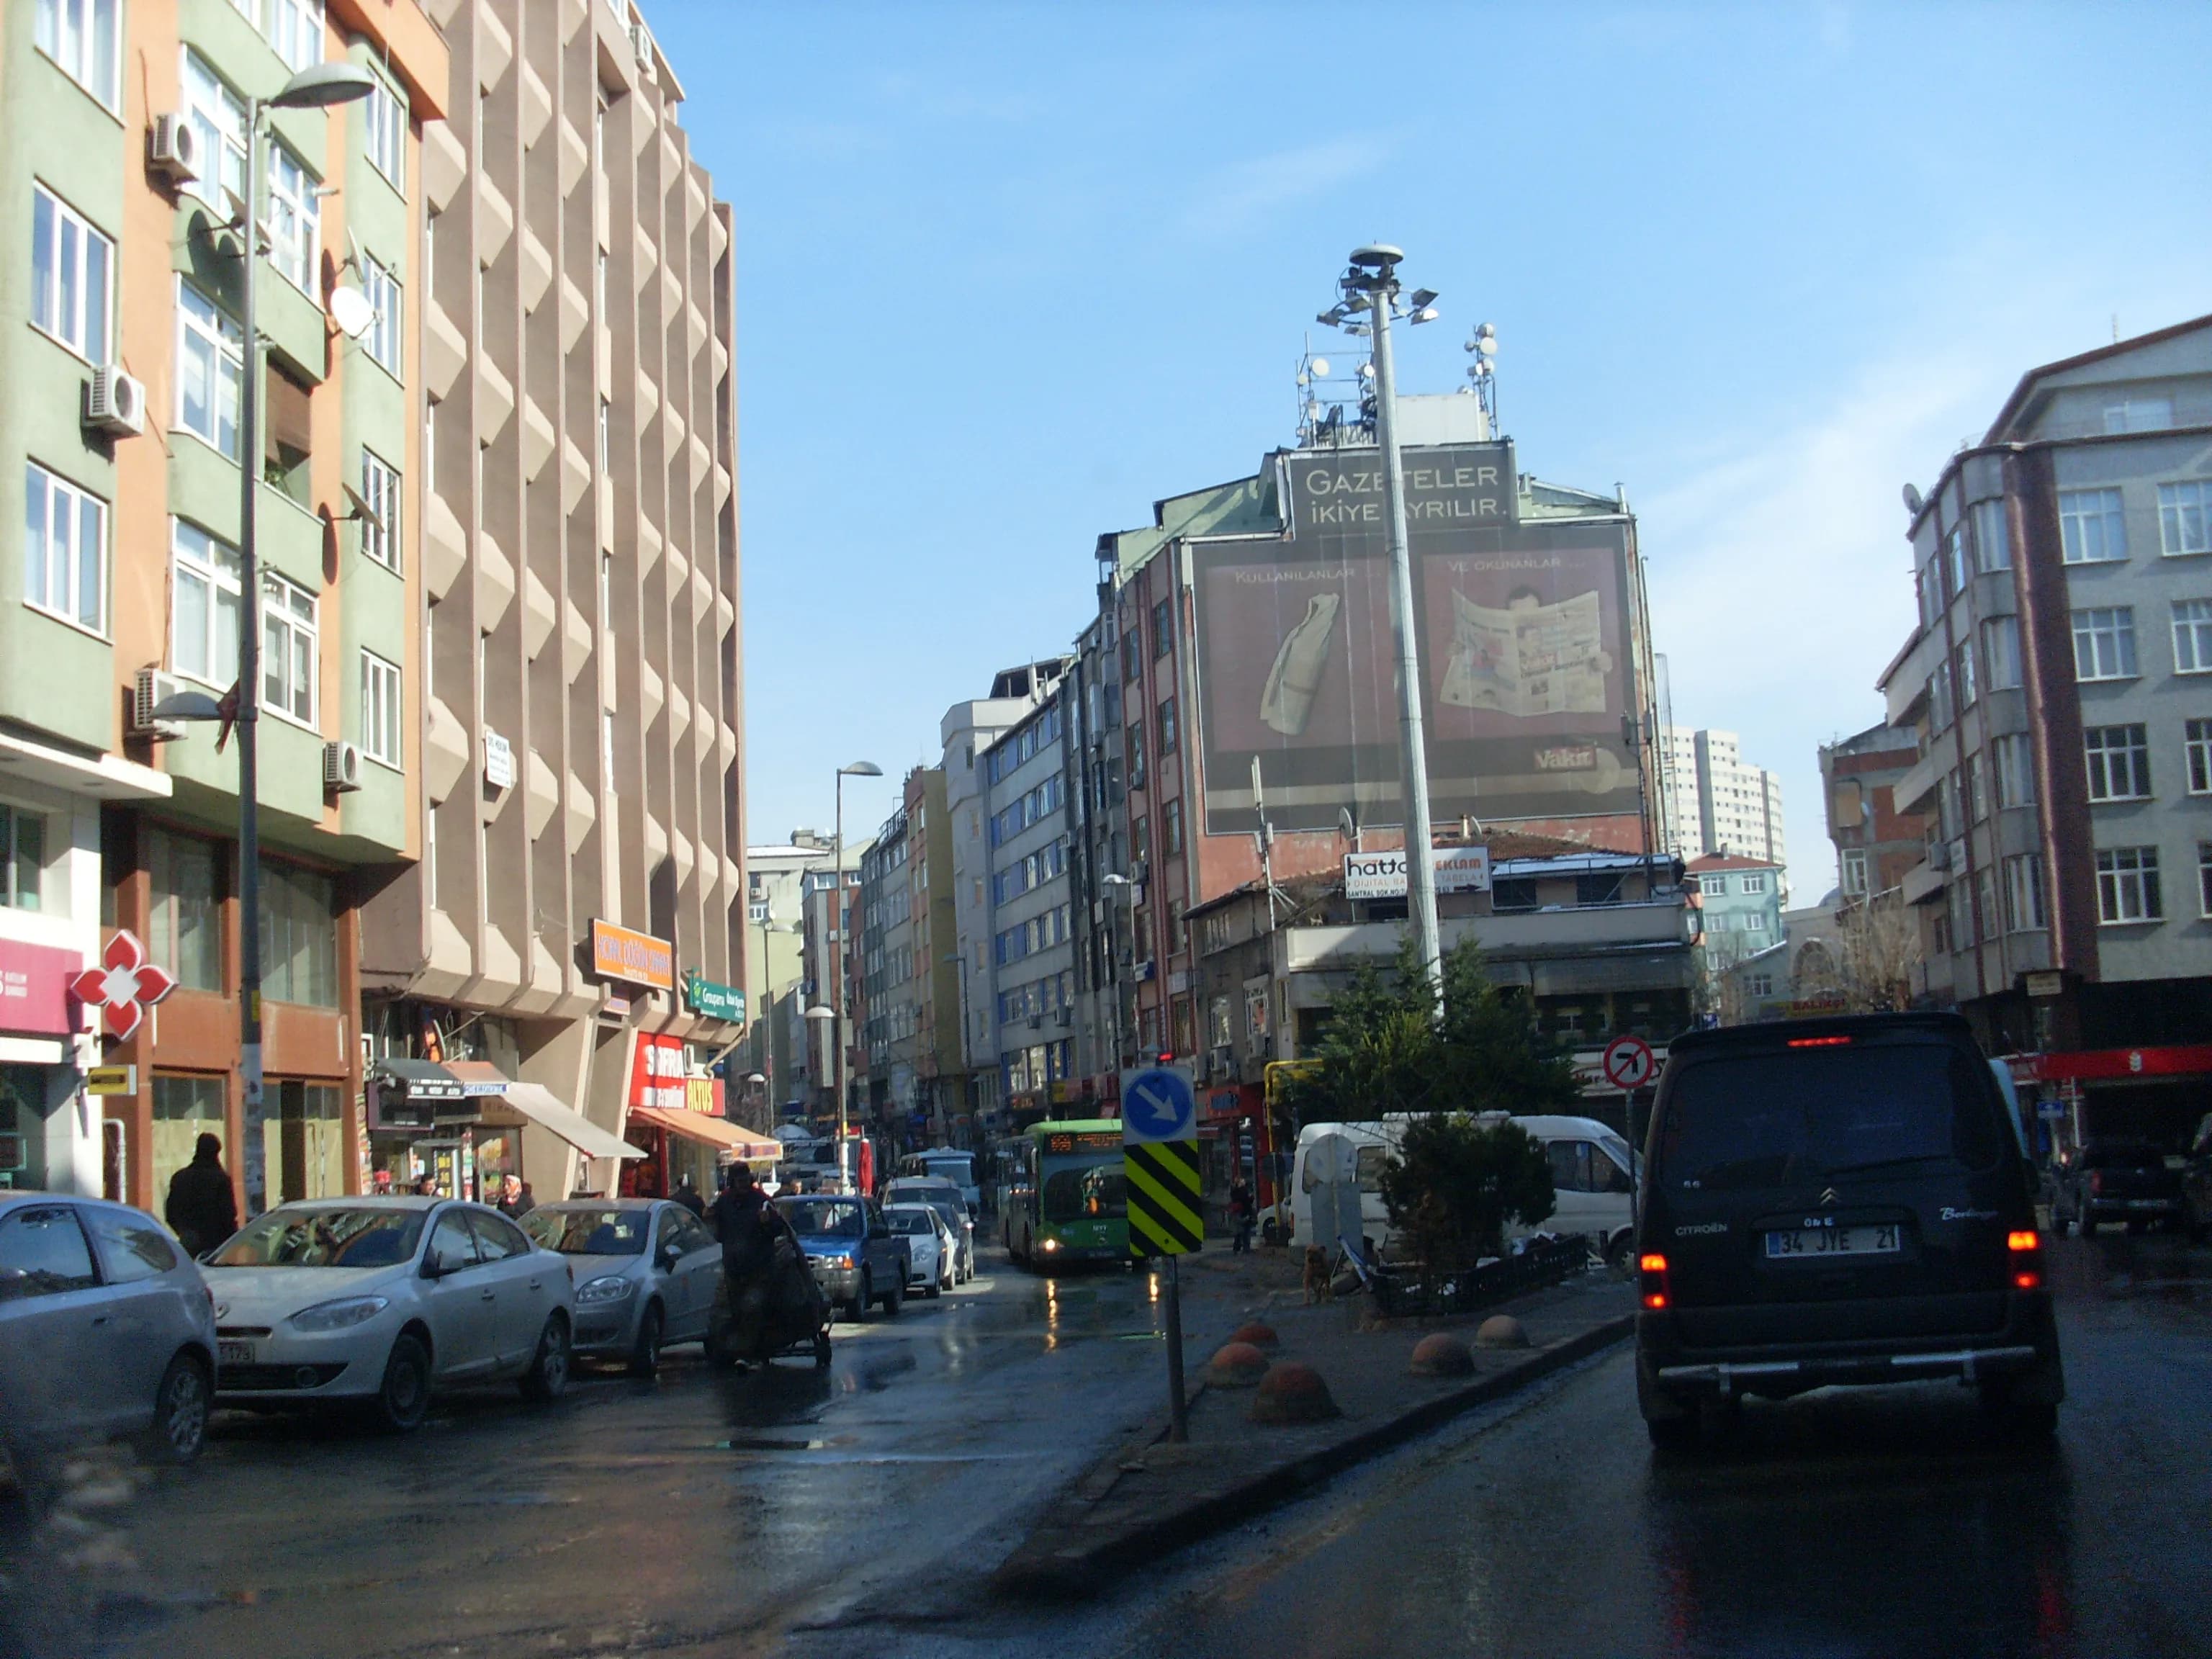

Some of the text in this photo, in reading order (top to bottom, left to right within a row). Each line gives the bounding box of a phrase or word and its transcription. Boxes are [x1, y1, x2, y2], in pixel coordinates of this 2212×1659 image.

[1305, 467, 1498, 495] GAZEELER
[1311, 500, 1380, 524] İKİYE
[687, 1079, 714, 1112] ALTUS
[1781, 1226, 1895, 1253] 34 JYE 21
